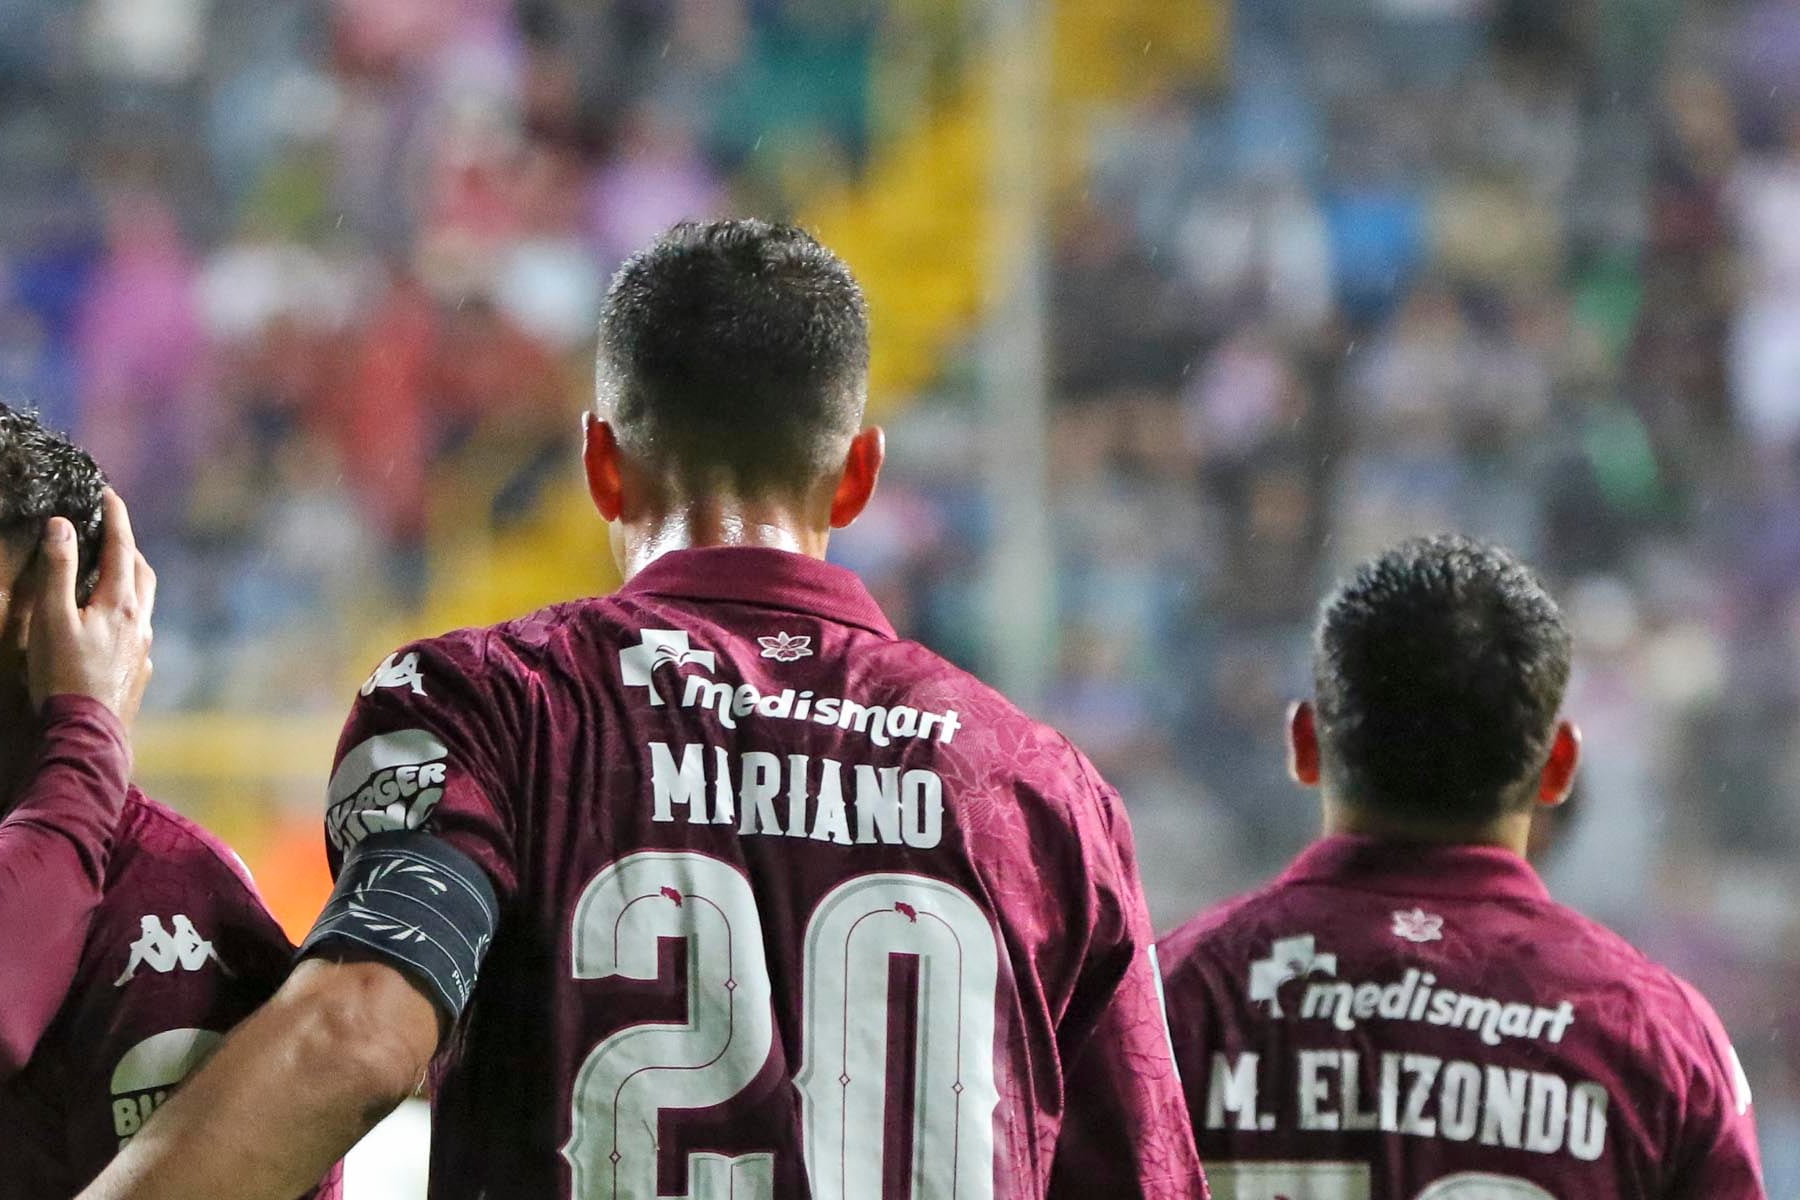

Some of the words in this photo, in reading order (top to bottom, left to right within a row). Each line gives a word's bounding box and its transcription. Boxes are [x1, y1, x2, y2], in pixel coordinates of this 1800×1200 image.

[682, 675, 962, 746] medismart
[648, 741, 944, 849] MARIANO
[1301, 968, 1574, 1046] medismart
[1206, 1051, 1276, 1131] M.
[1298, 1048, 1609, 1161] ELIZONDO
